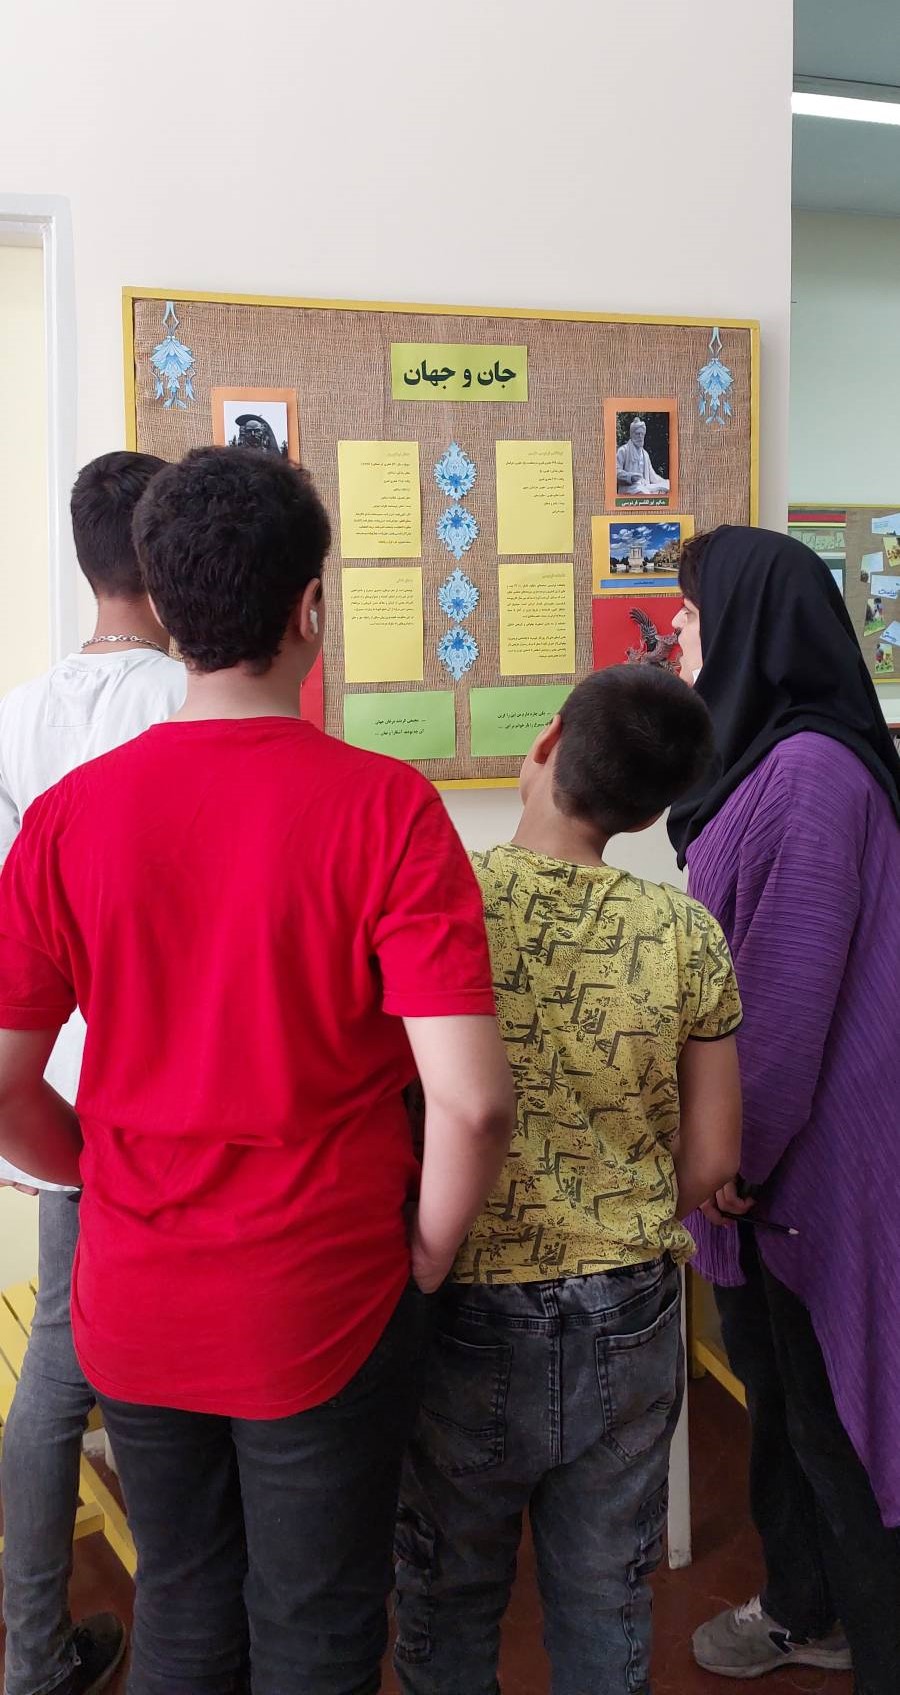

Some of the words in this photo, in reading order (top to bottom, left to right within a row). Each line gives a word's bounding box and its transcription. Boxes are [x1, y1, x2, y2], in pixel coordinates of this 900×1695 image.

[403, 359, 456, 390] جهان
[462, 368, 472, 388] و
[477, 360, 517, 389] جان
[621, 499, 638, 507] فردوسی
